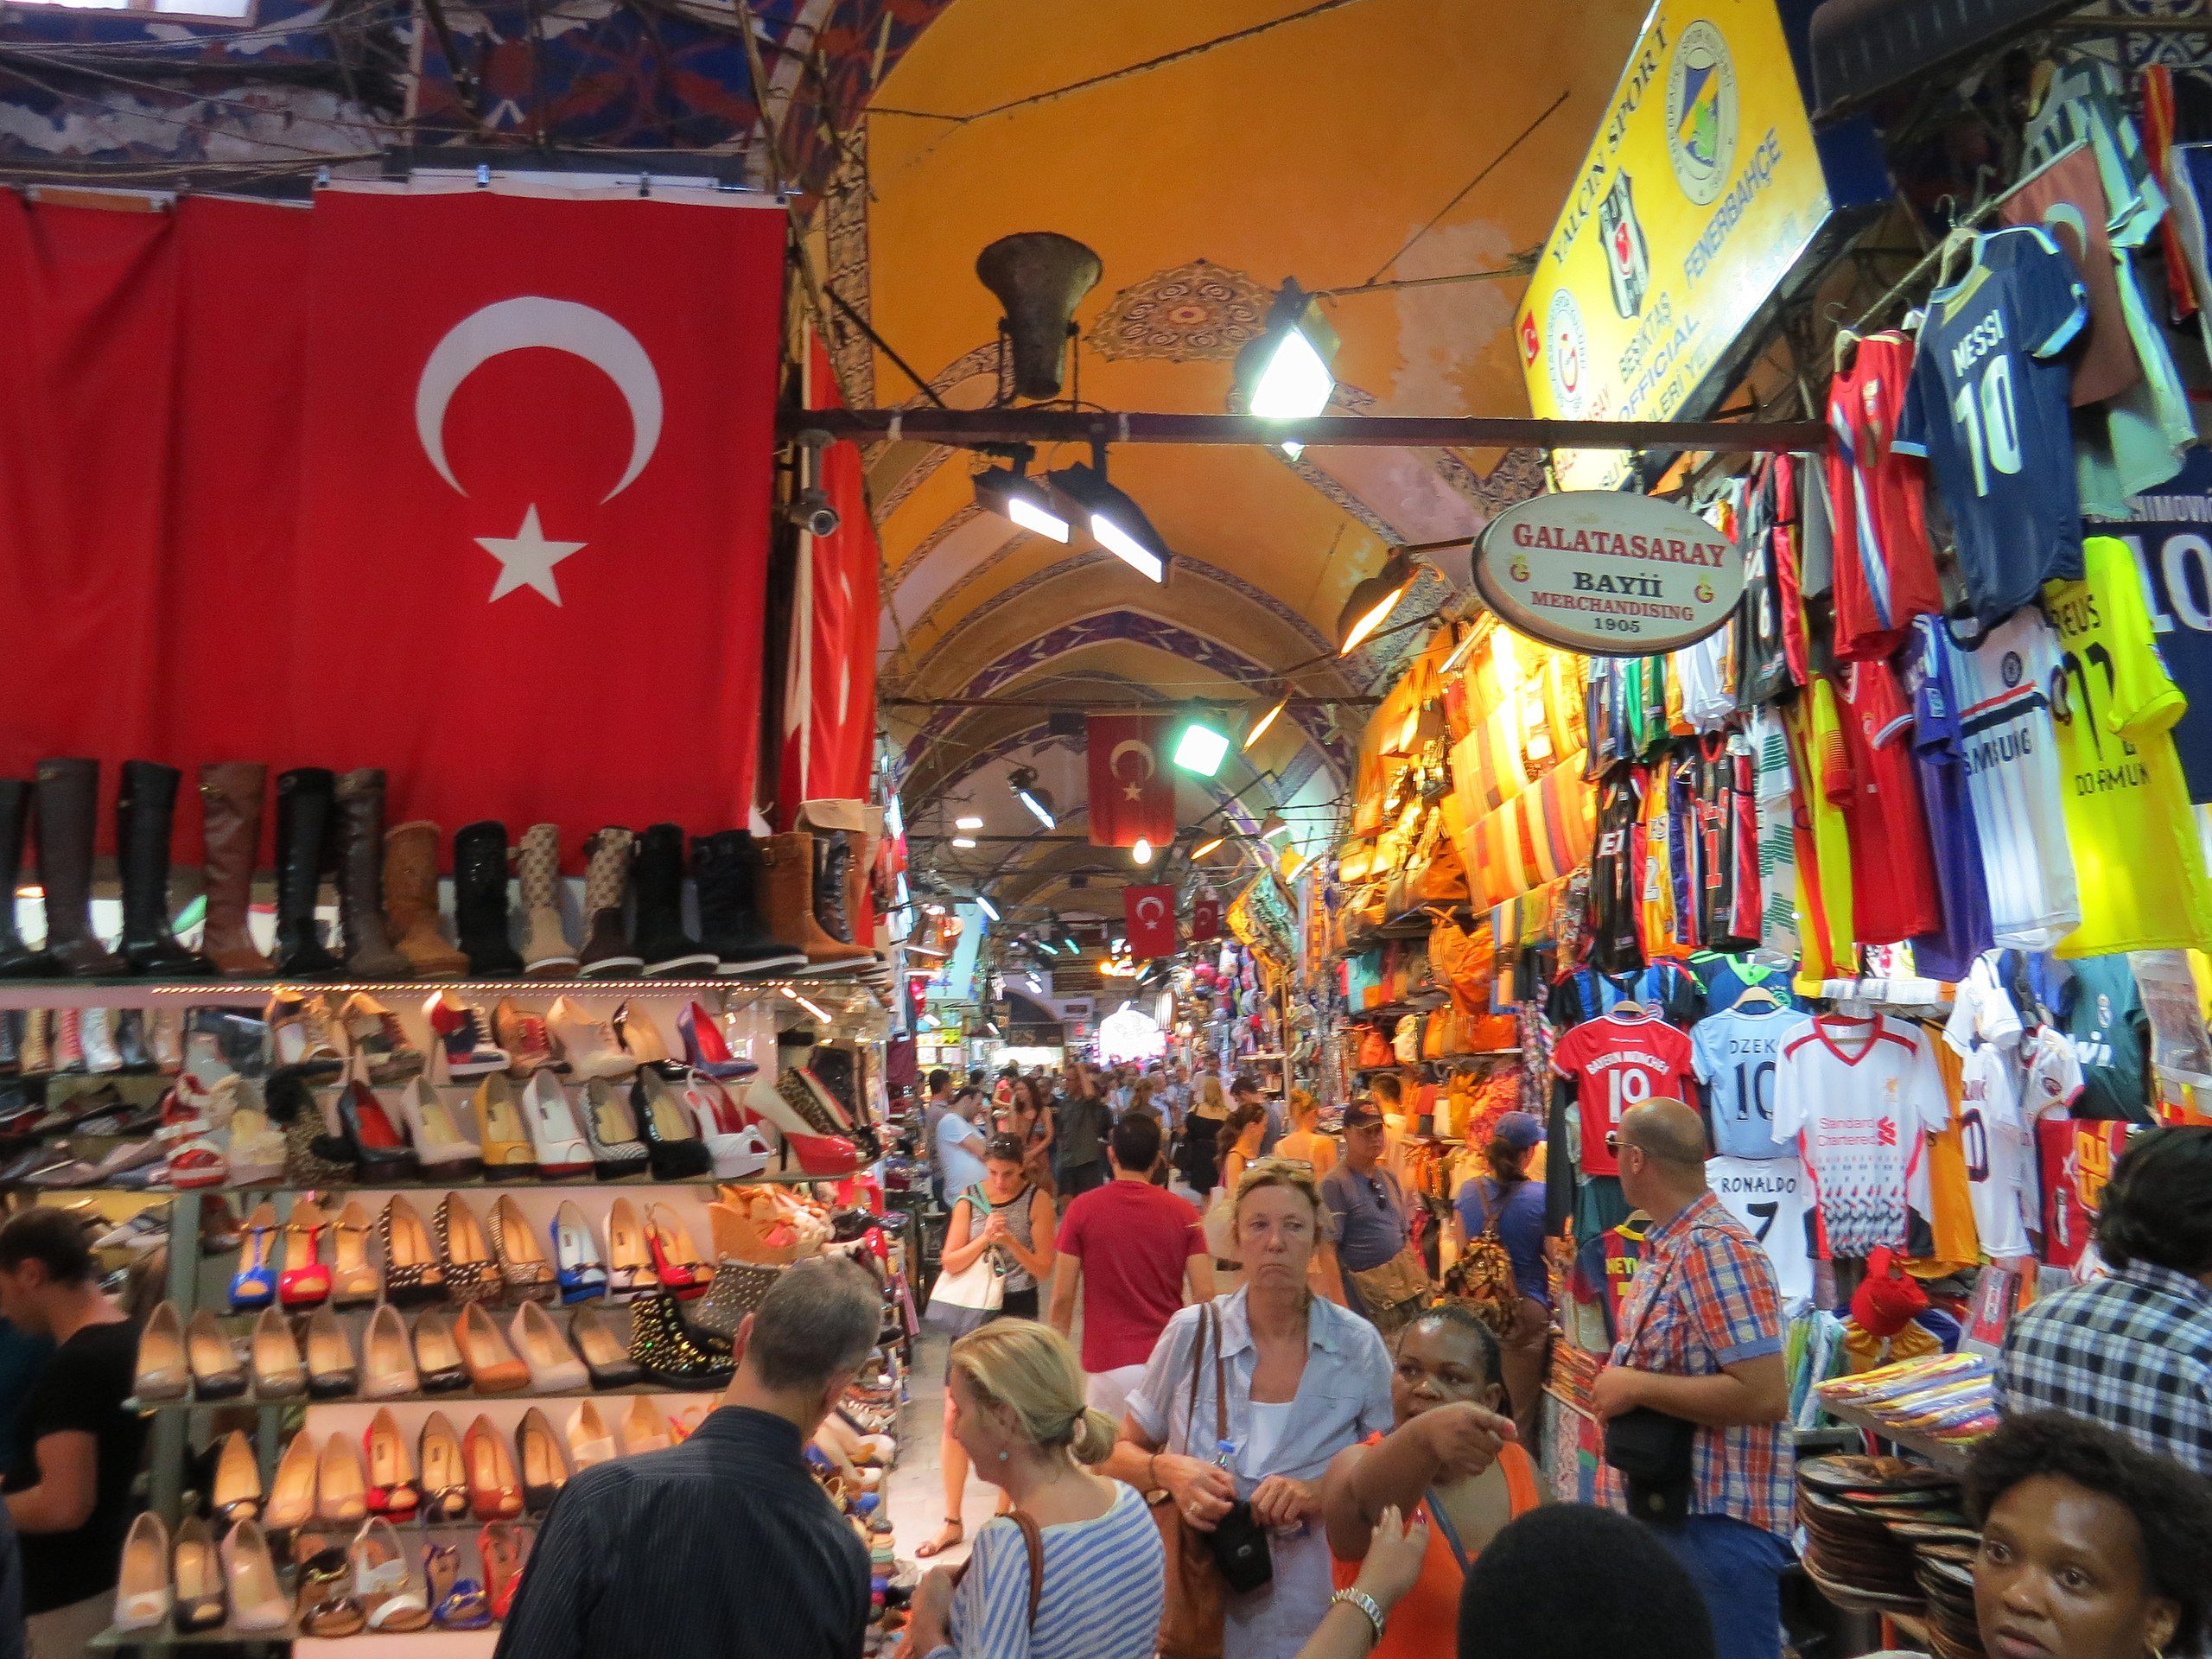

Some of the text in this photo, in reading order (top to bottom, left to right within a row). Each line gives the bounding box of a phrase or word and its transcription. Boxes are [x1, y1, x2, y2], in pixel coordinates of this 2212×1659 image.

[1951, 309, 2005, 378] MESSI
[1954, 355, 2023, 498] 10
[1512, 523, 1727, 568] GALATASARAY
[1530, 591, 1695, 621] MERCHANDISING
[1593, 617, 1641, 633] 1905
[1730, 1039, 1777, 1055] DZEK
[1721, 1177, 1797, 1194] RONALDO
[1746, 1200, 1779, 1244] 7
